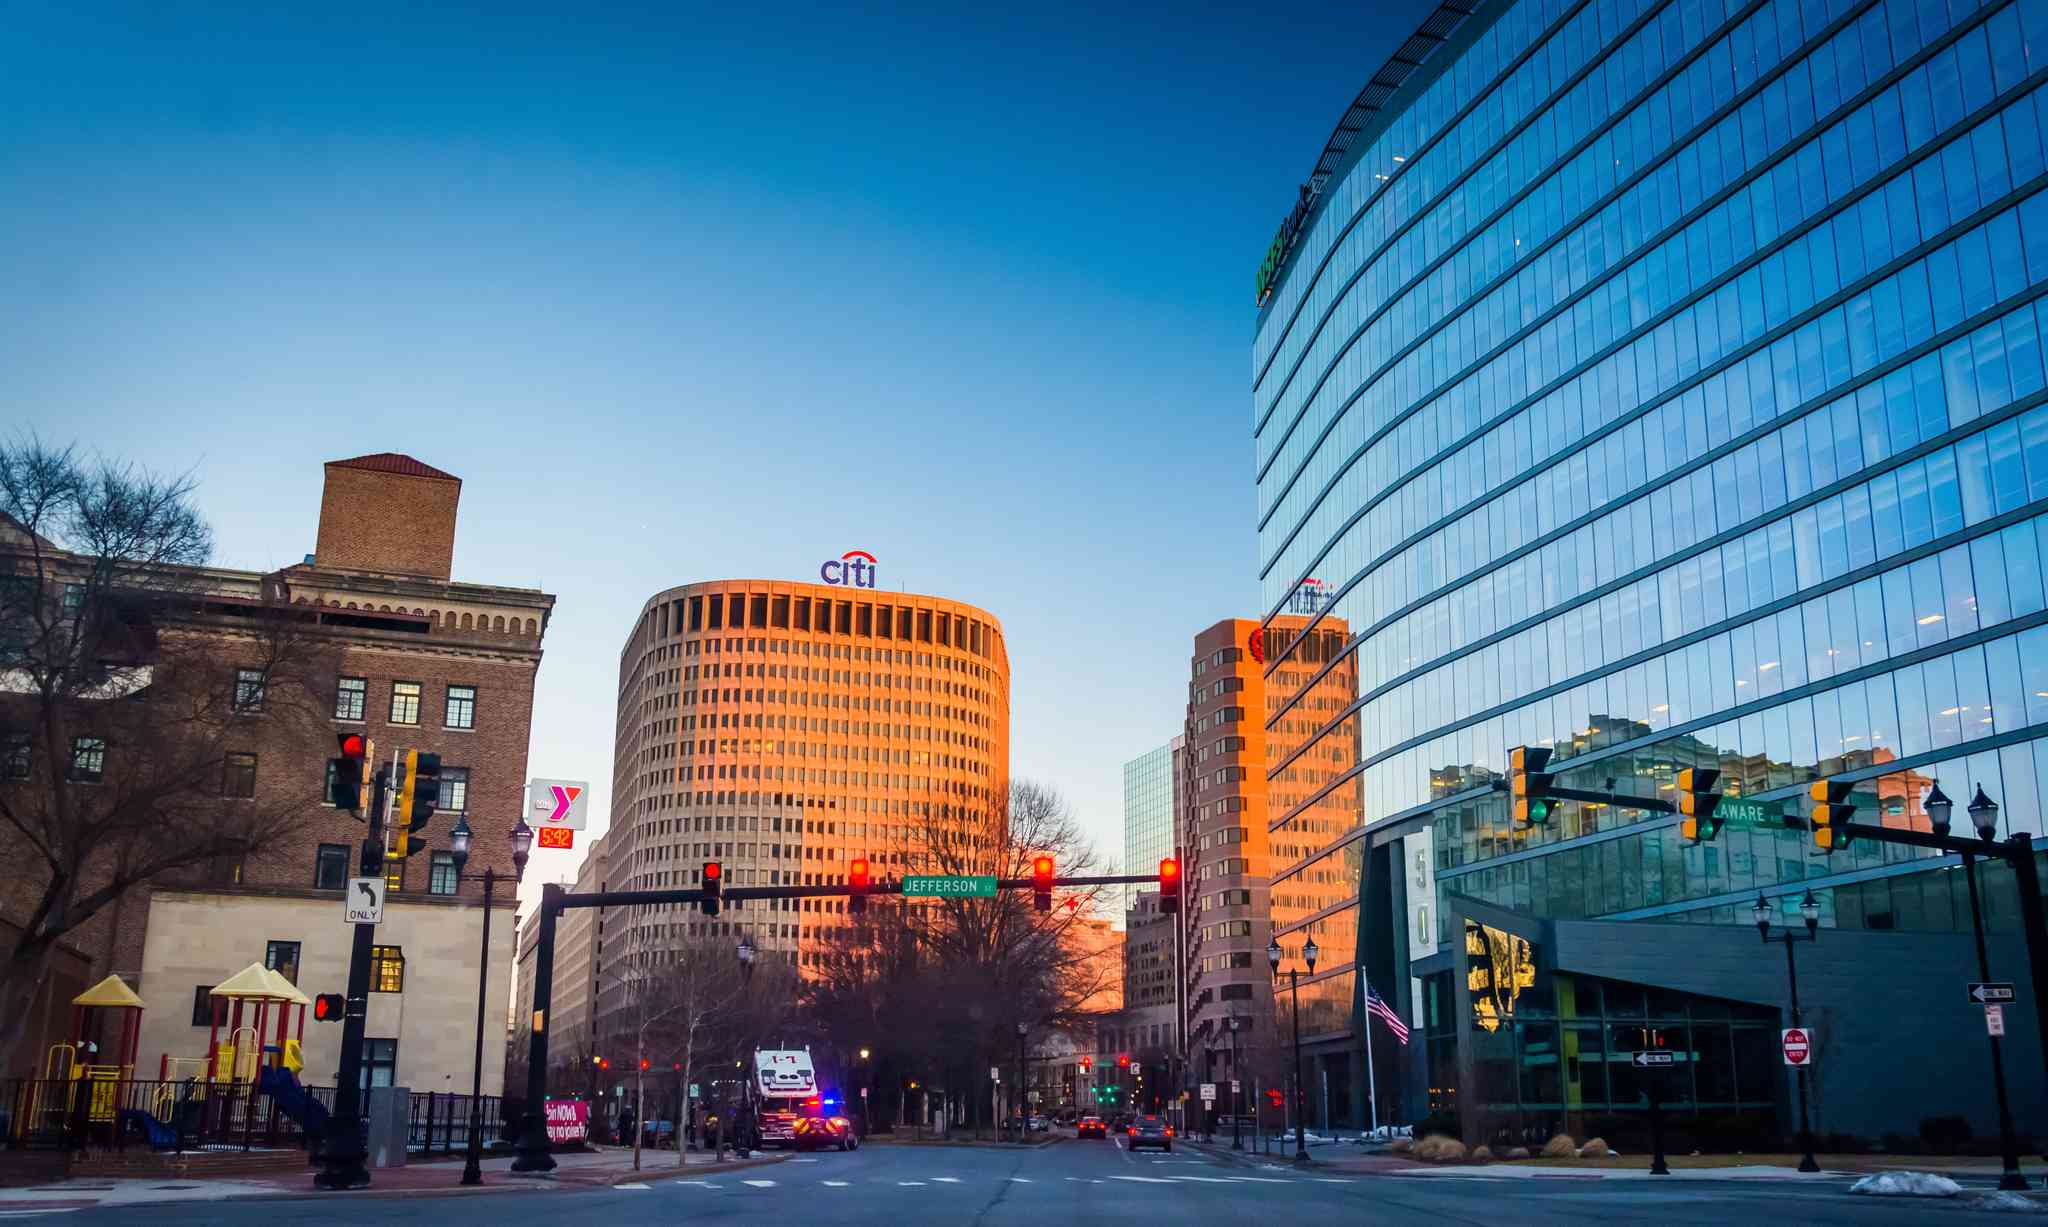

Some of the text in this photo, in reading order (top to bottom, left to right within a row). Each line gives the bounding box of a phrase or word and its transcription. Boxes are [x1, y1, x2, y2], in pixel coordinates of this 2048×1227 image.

[821, 551, 877, 588] citi
[1712, 804, 1766, 822] LAWARE
[542, 828, 570, 845] 5:42
[905, 880, 977, 893] JEFFERSON
[350, 910, 377, 919] ONLY
